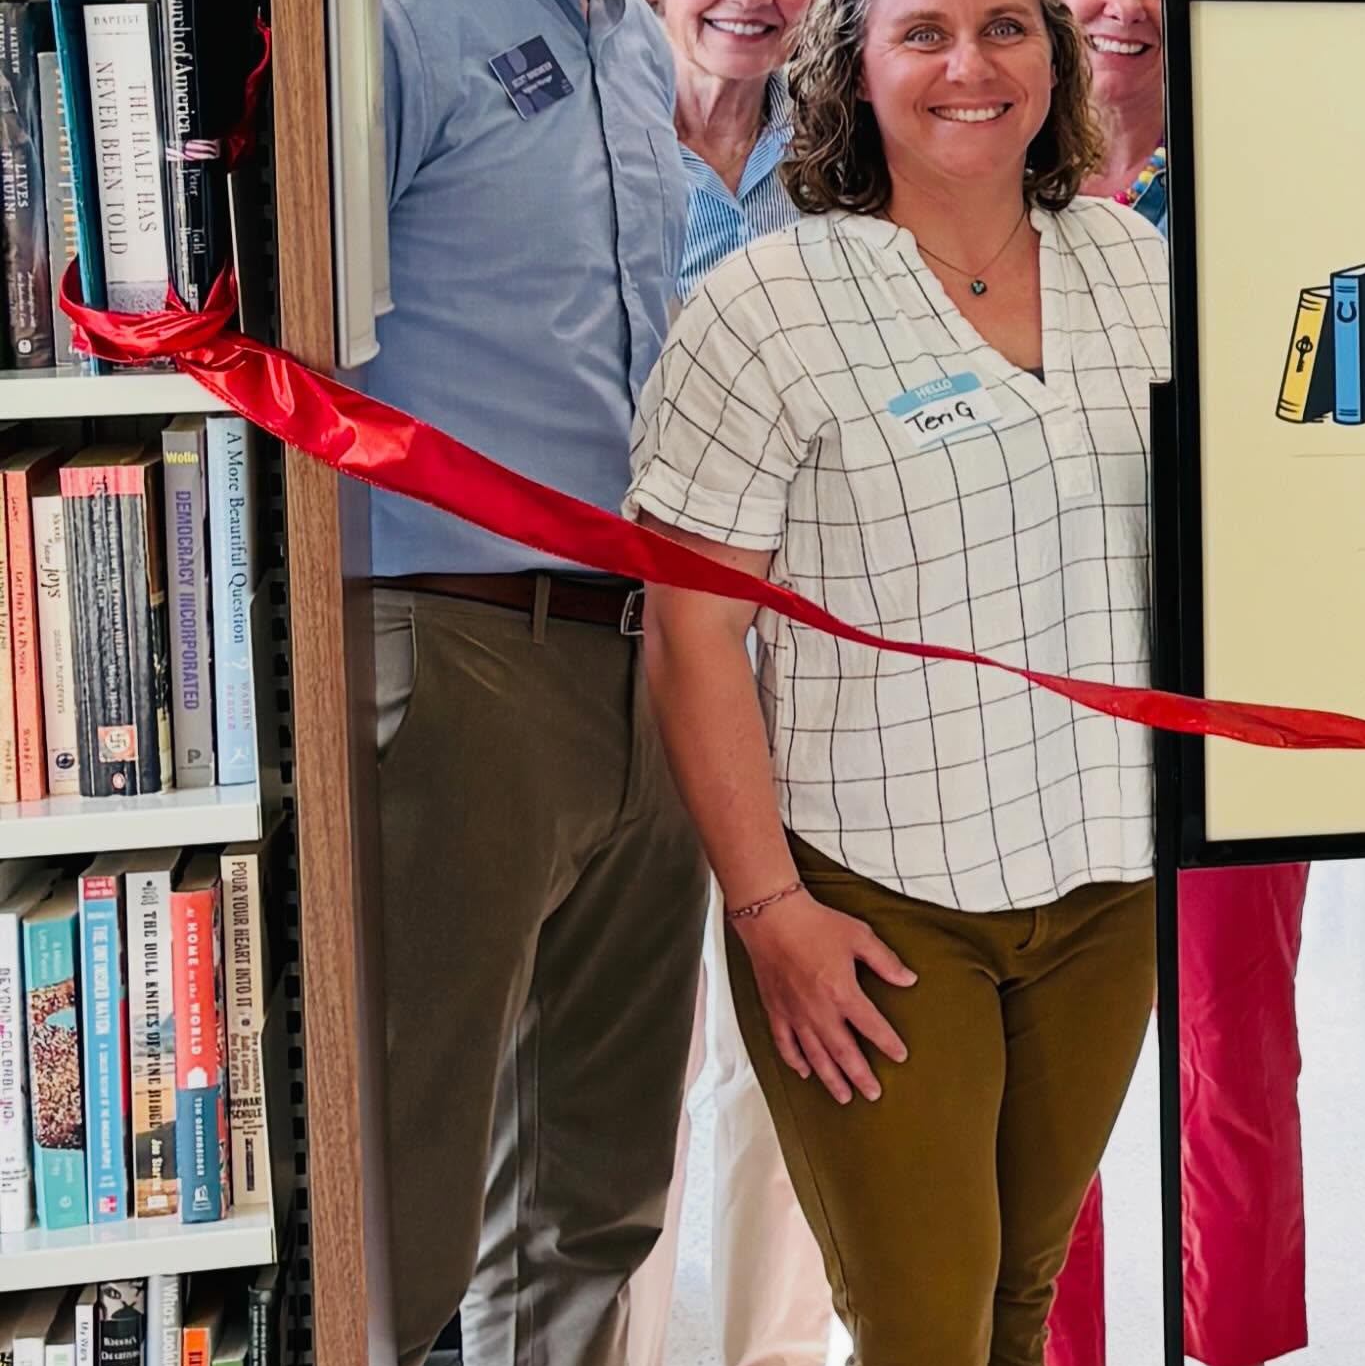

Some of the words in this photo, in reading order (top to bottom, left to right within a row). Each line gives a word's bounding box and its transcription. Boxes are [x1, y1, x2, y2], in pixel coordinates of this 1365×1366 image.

[173, 41, 194, 60] of
[95, 61, 119, 130] NEVER
[128, 83, 149, 123] THE
[174, 61, 196, 134] America
[2, 151, 14, 169] IN
[101, 138, 124, 191] BEEN
[131, 131, 154, 184] HALF
[4, 172, 16, 220] RUINS
[16, 163, 29, 208] LIVES
[106, 201, 129, 255] TOLD
[136, 192, 157, 233] HAS
[914, 379, 953, 399] HELLO
[166, 450, 198, 465] Wolin
[227, 431, 239, 445] A
[227, 450, 243, 492] More
[174, 490, 195, 587] DEMOCRACY
[229, 497, 247, 567] Beautiful
[228, 571, 248, 645] Question
[179, 592, 200, 711] INCORPORATED
[241, 682, 251, 730] WARREN
[231, 861, 247, 893] POUR
[143, 910, 157, 937] THE
[232, 894, 249, 927] YOUR
[145, 943, 158, 976] DULL
[187, 922, 199, 967] HOME
[233, 928, 251, 965] HEART
[0, 968, 12, 1024] BEYOND
[235, 967, 252, 996] INTO
[145, 981, 160, 1028] KNIFES
[236, 997, 253, 1008] IT
[147, 1032, 160, 1049] OF
[189, 1002, 202, 1056] WORLD
[230, 1032, 239, 1047] One
[147, 1052, 161, 1085] PINE
[241, 1059, 251, 1091] Company
[148, 1088, 162, 1129] RIDGE
[161, 1283, 178, 1327] Who's
